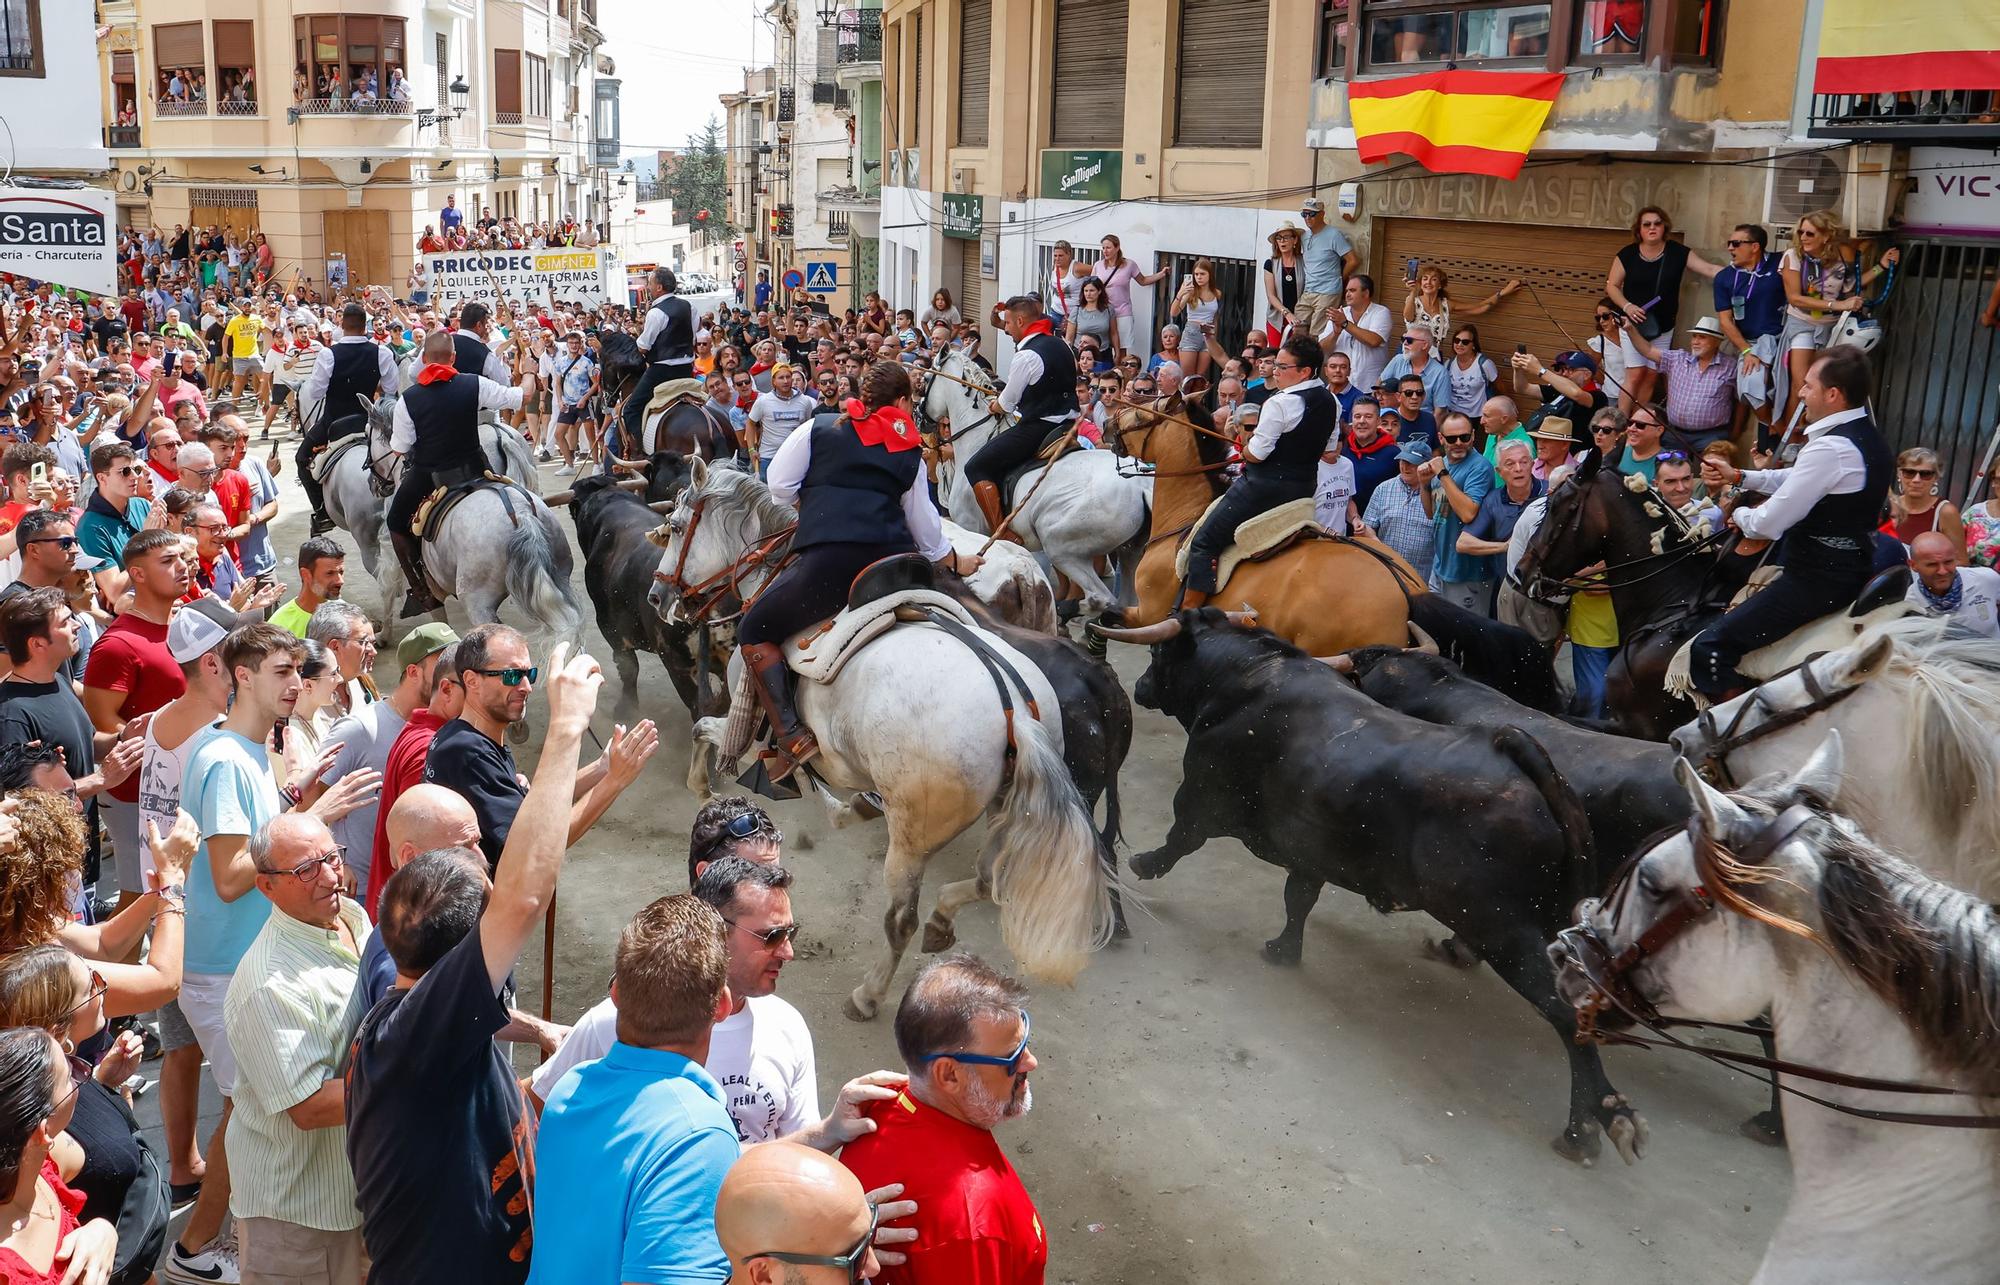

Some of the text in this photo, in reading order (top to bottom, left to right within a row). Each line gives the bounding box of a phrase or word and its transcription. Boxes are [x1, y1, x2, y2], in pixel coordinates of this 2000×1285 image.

[1935, 175, 2000, 197] VIC
[2, 215, 103, 243] Santa
[0, 250, 23, 260] ería
[35, 250, 102, 260] Charcutería
[433, 256, 532, 274] BRICODEC
[432, 276, 489, 288] ALQUILER
[577, 284, 601, 294] 44
[722, 1075, 751, 1086] LEAL
[756, 1082, 764, 1092] Y
[733, 1094, 756, 1107] PEÑA
